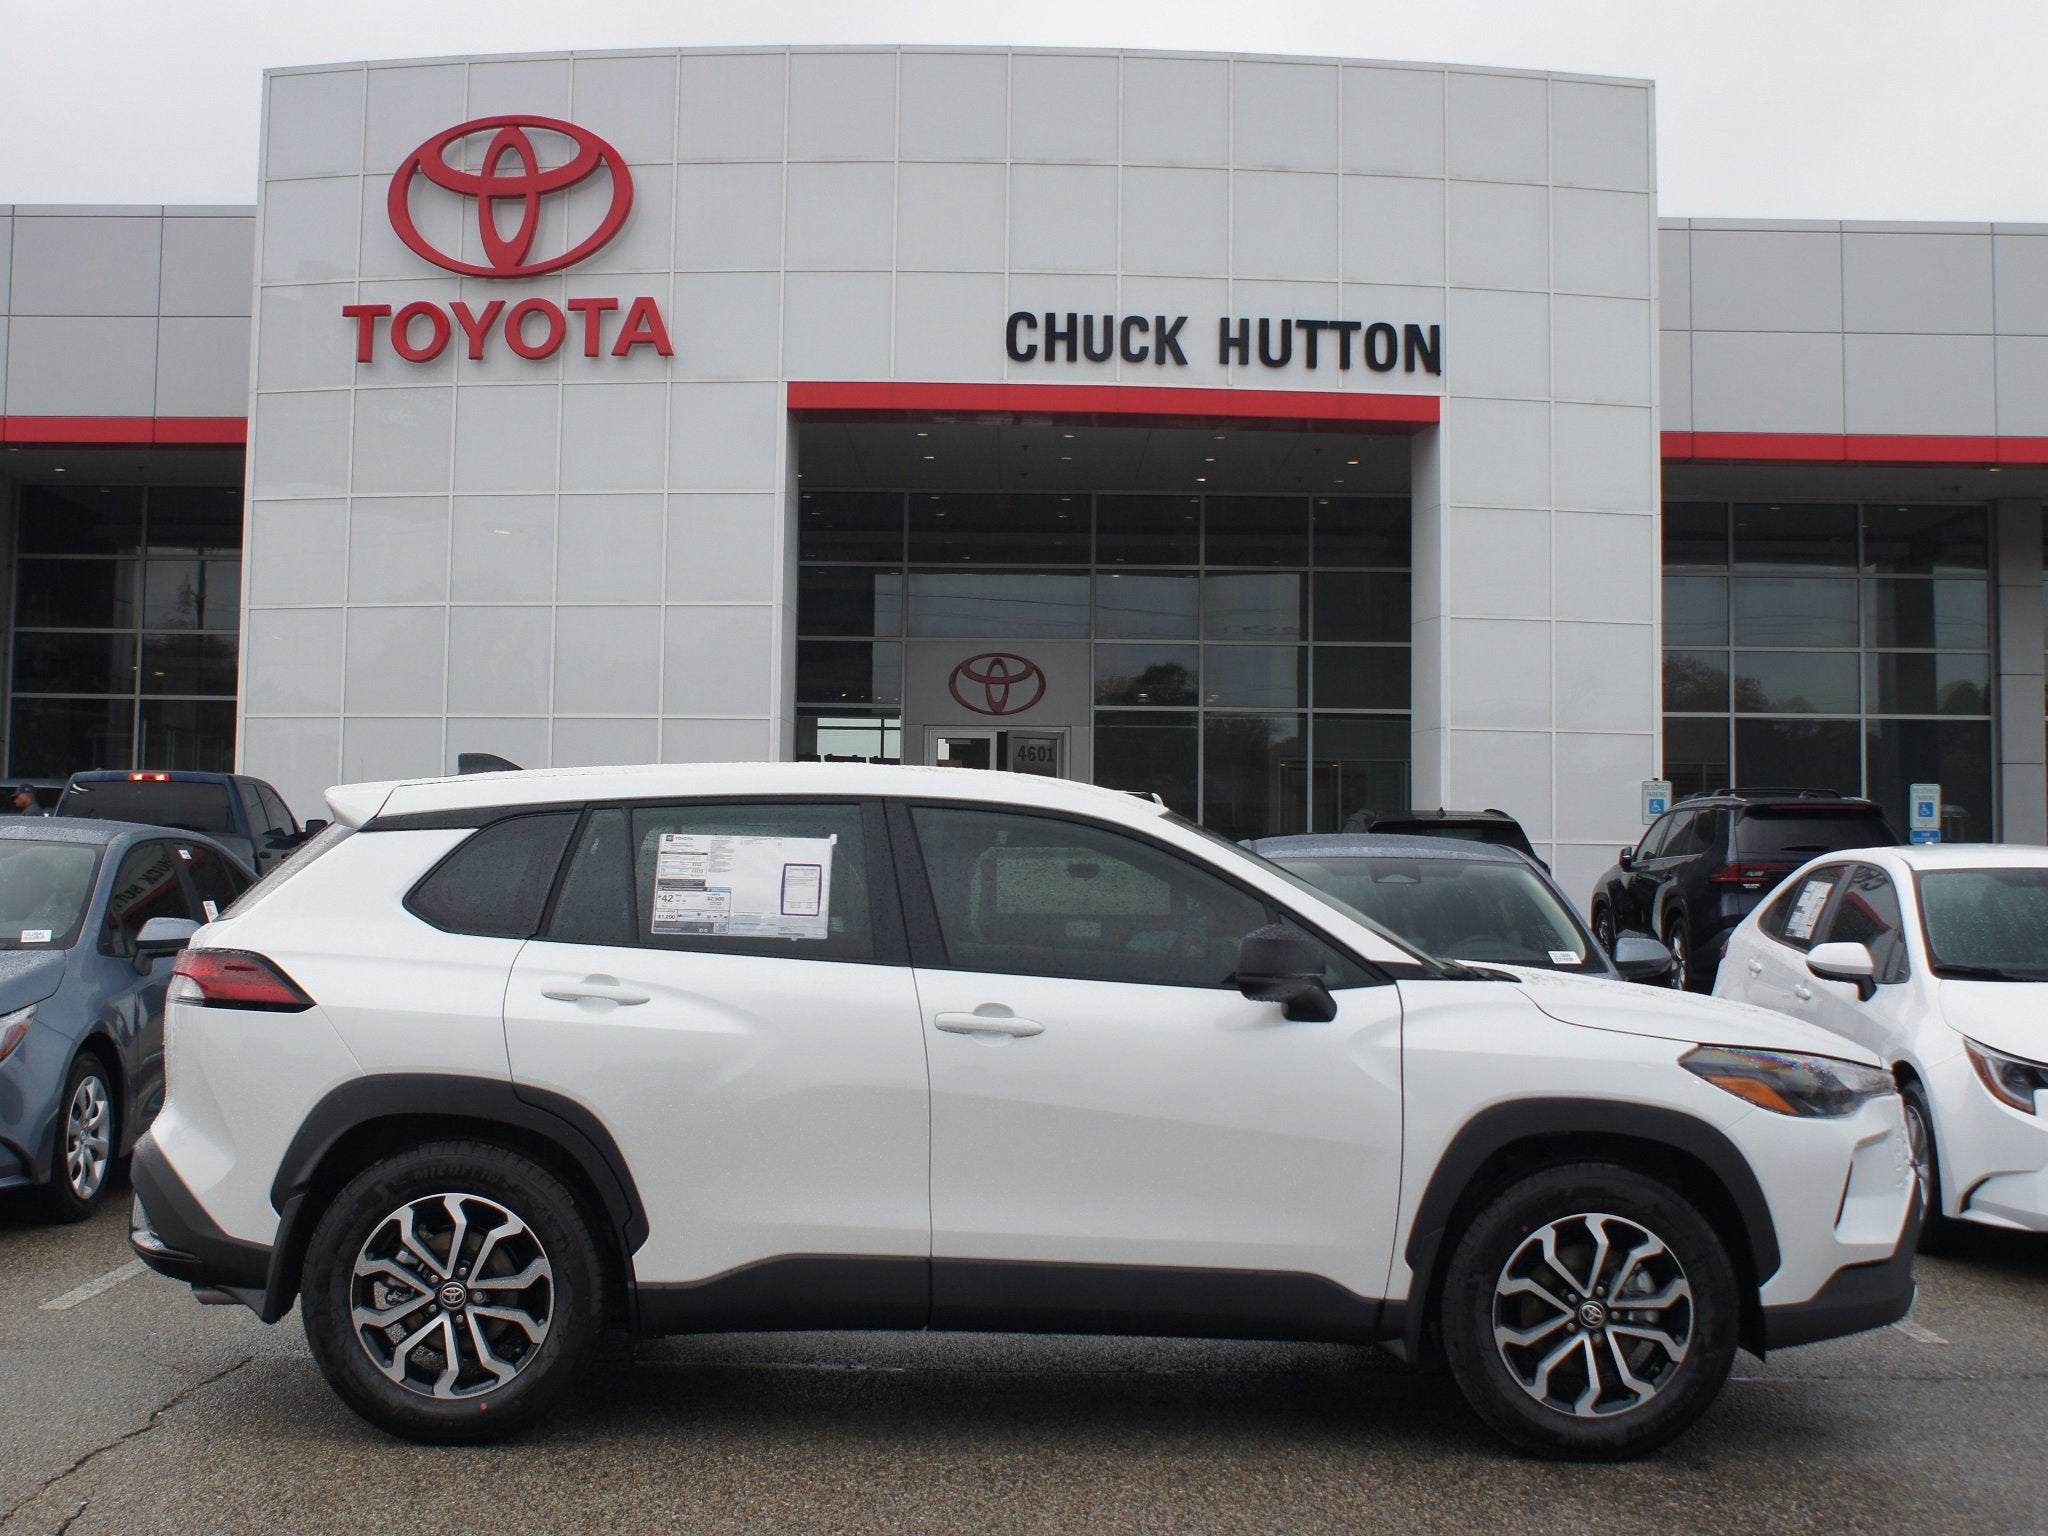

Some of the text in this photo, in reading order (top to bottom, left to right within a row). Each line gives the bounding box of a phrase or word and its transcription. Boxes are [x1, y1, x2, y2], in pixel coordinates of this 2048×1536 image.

[342, 296, 675, 363] TOYOTA
[1005, 311, 1442, 375] CHUCK HUTTON
[1017, 745, 1056, 763] 4601
[661, 894, 674, 902] 42
